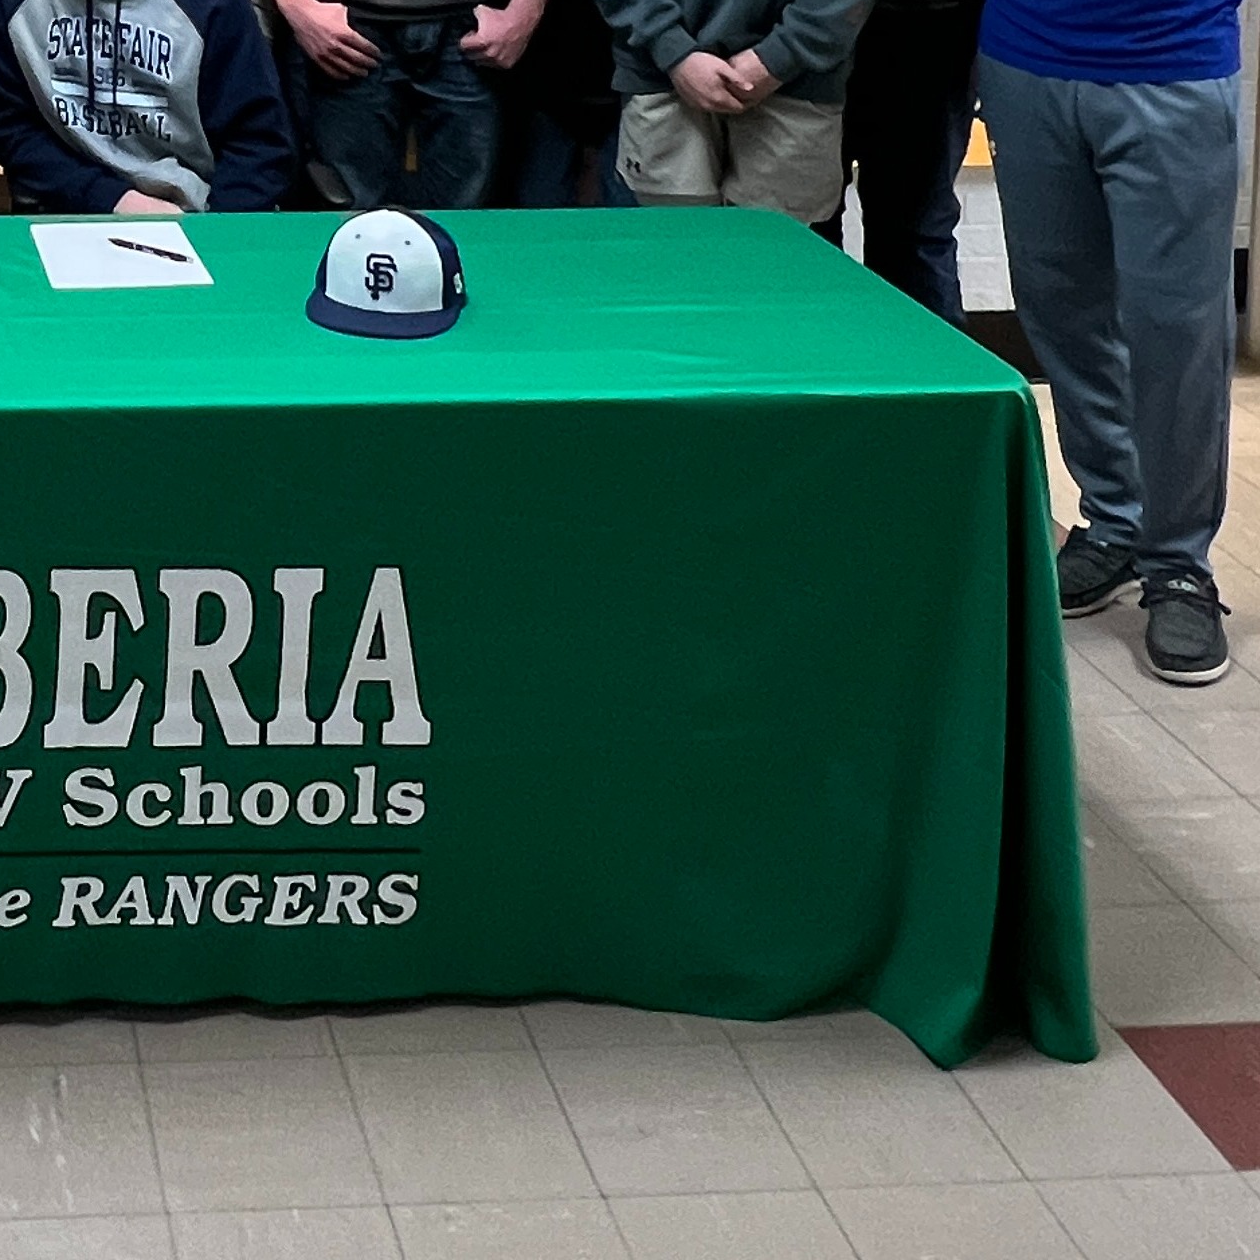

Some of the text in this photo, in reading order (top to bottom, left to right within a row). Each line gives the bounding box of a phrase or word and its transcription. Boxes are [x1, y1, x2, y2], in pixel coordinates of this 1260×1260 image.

[115, 22, 173, 81] FAIR
[53, 97, 172, 143] BASEBALL
[62, 765, 425, 827] Schools
[51, 873, 420, 928] RANGERS
